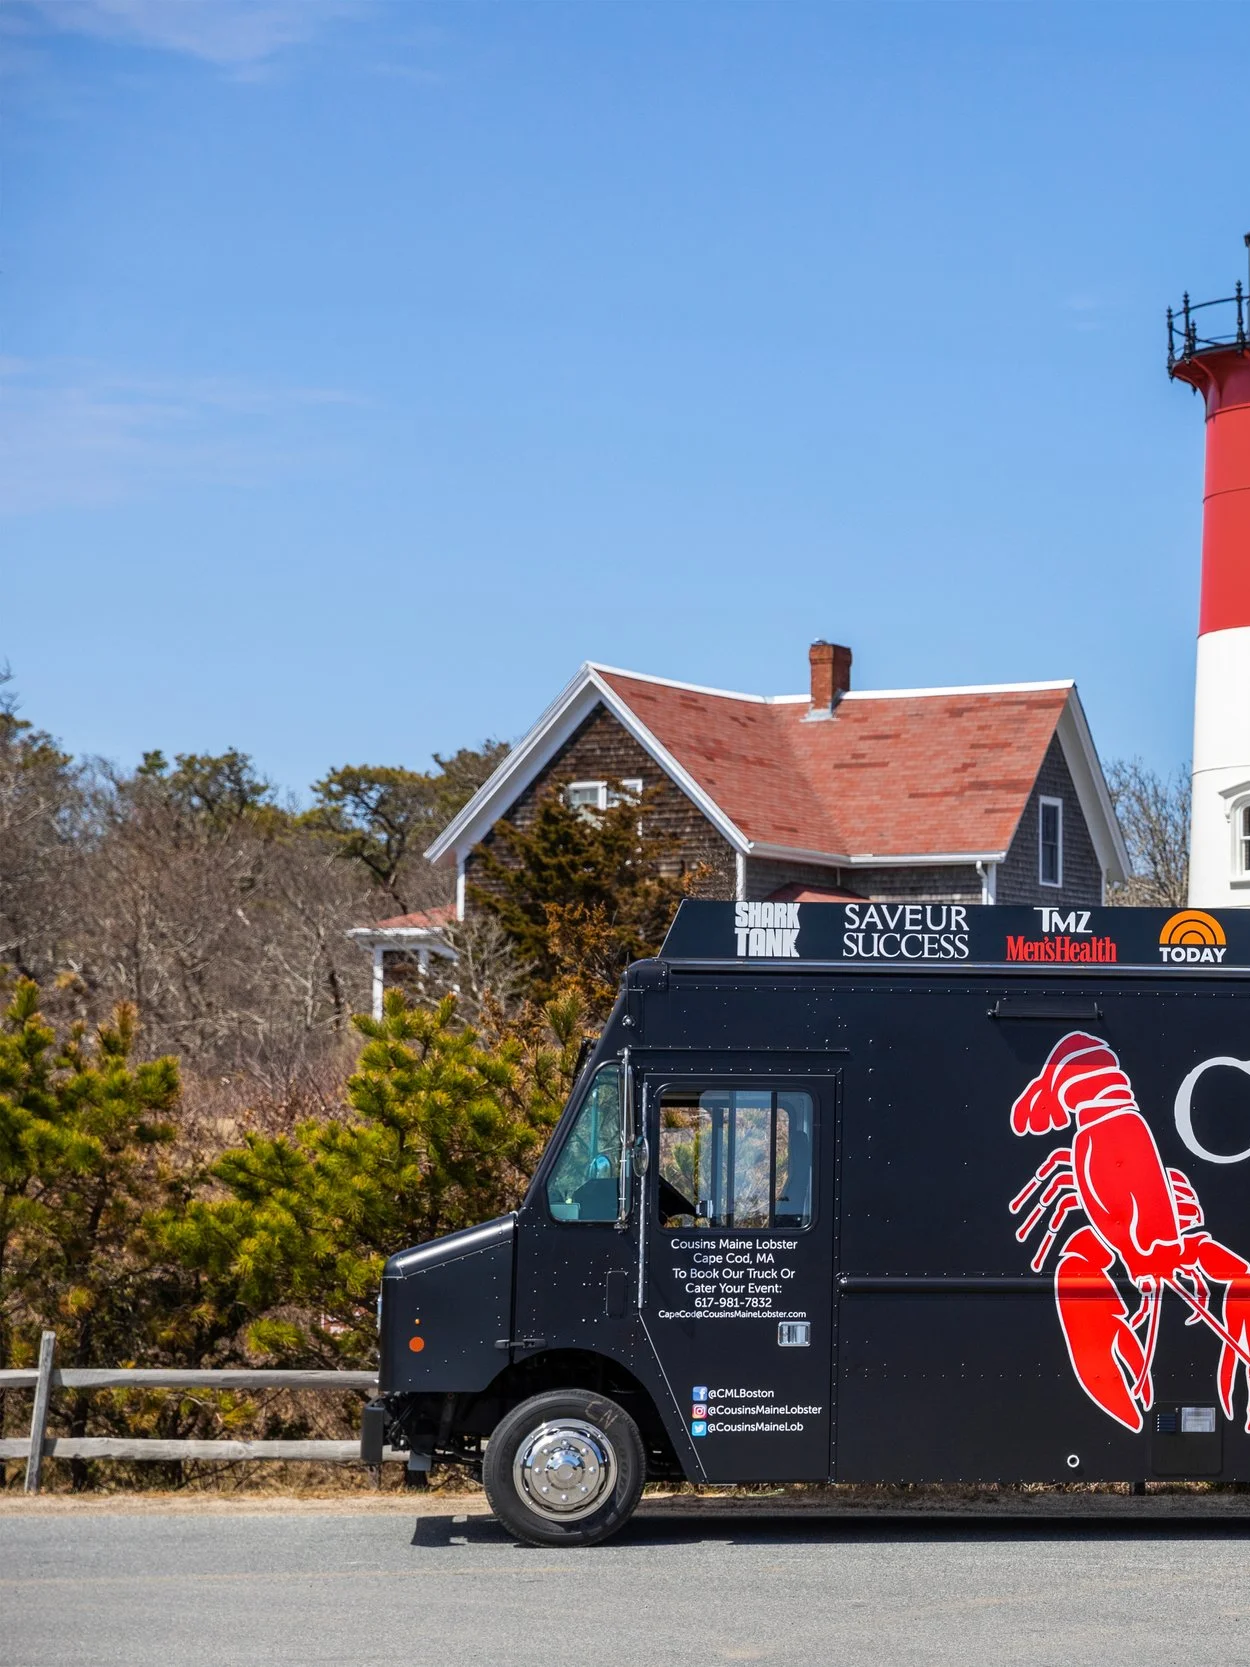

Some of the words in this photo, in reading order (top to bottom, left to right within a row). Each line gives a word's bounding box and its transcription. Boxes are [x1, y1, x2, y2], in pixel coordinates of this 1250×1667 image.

[734, 902, 800, 928] SHARK
[843, 902, 971, 931] SAVEUR
[1033, 907, 1092, 933] TMZ
[734, 928, 800, 958] TANK
[843, 932, 969, 959] SUCCESS
[1159, 947, 1226, 962] TODAY
[671, 1239, 716, 1249] Cousins
[719, 1239, 752, 1249] Maine
[756, 1239, 798, 1249] Lobster
[694, 1253, 723, 1265] Cape
[726, 1253, 752, 1264] Cod,
[756, 1253, 774, 1263] MA
[672, 1268, 687, 1278] To
[691, 1268, 719, 1278] Book
[722, 1268, 744, 1278] Our
[747, 1268, 777, 1278] Truck
[781, 1268, 795, 1278] Or
[685, 1283, 716, 1293] Cater
[719, 1283, 745, 1293] Your
[748, 1283, 782, 1293] Event:
[695, 1297, 771, 1307] 617-981-7832
[659, 1310, 806, 1319] CapeCod@CousinsMaineLobster.com
[707, 1389, 774, 1399] @CMLBoston
[708, 1405, 822, 1416] @CousinsMaineLobster
[707, 1422, 803, 1433] @CousinsMaineLob
